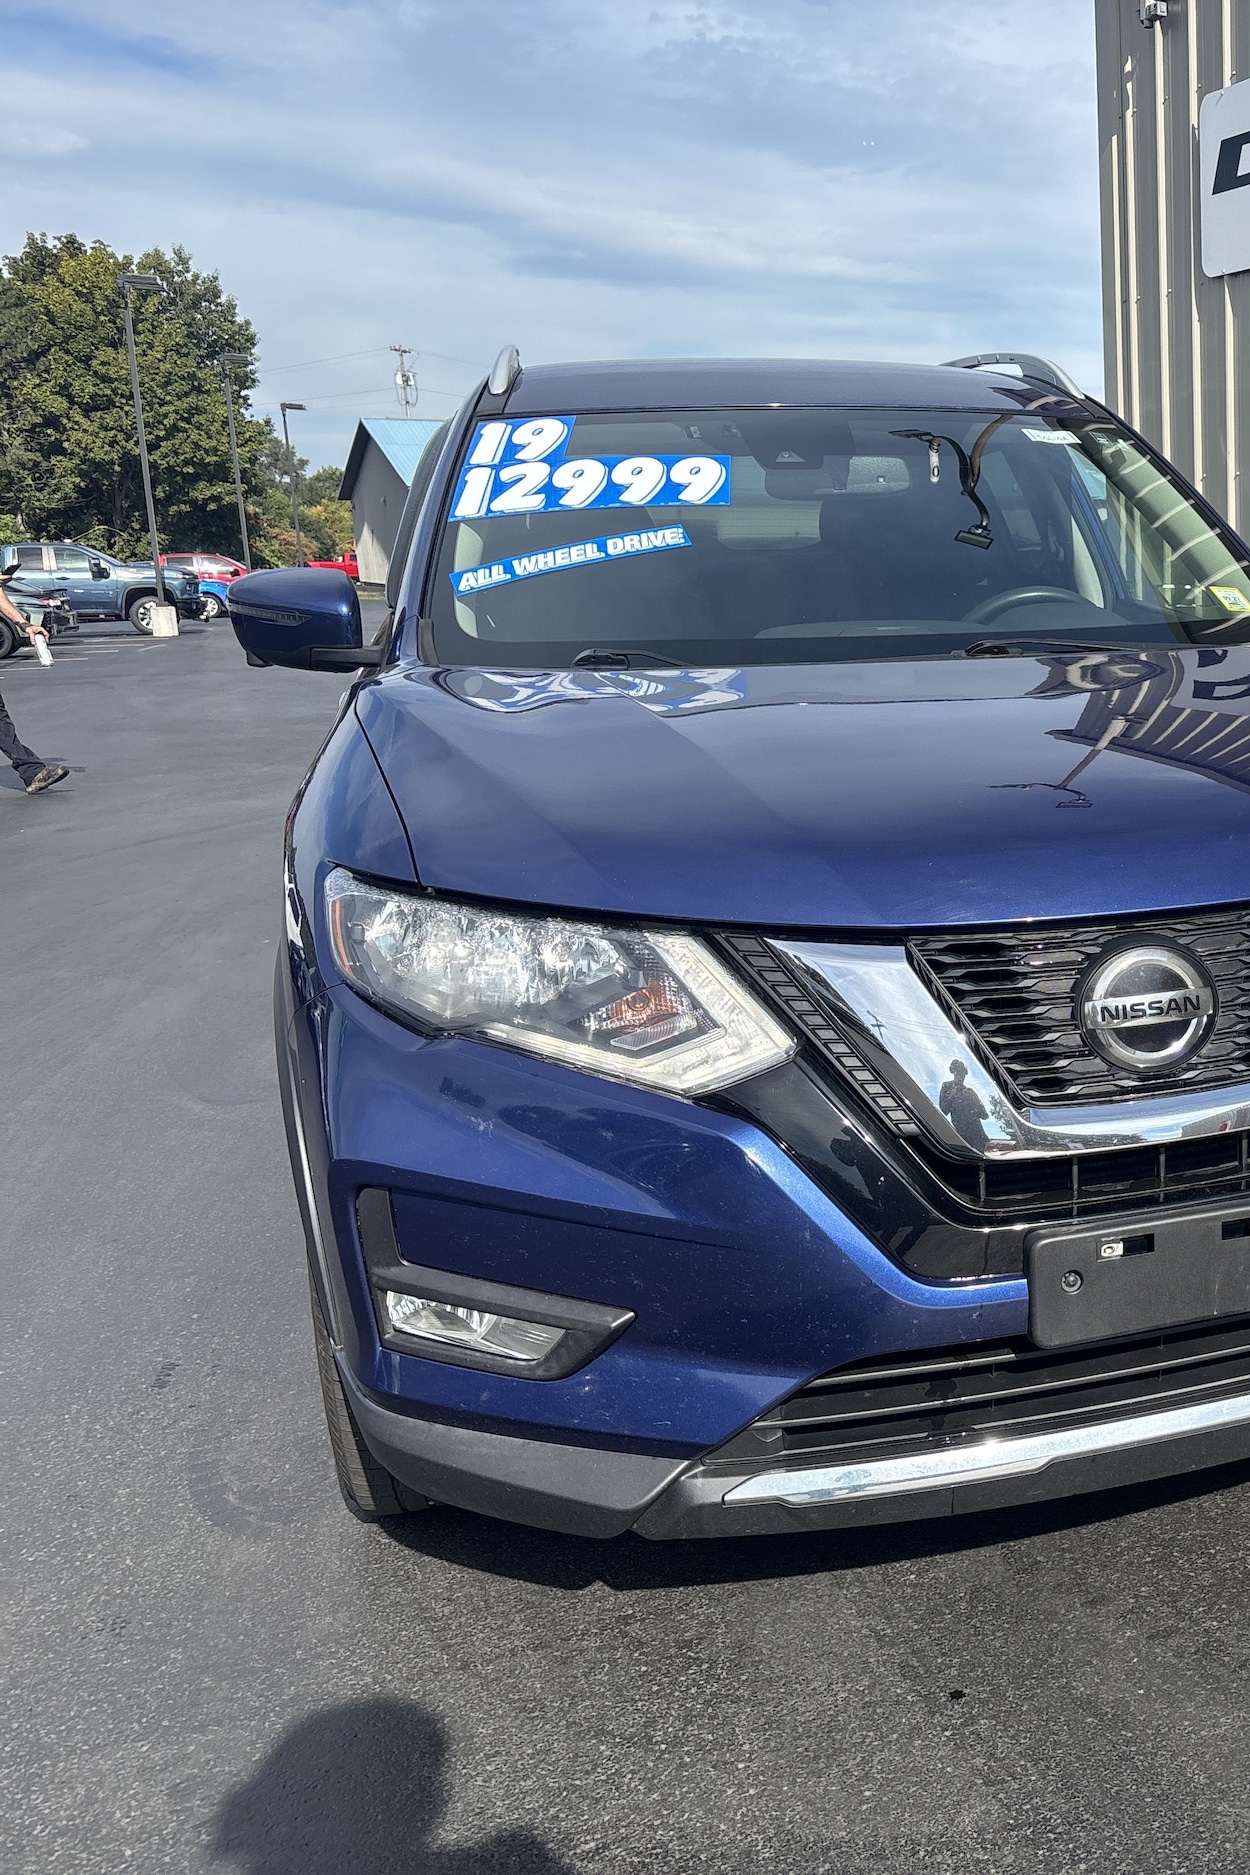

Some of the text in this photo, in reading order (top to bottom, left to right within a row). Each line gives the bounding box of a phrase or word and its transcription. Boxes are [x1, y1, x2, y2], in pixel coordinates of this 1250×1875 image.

[469, 418, 568, 465] 19
[454, 457, 727, 517] 12999
[457, 527, 684, 592] ALL WHEEL DRIVE
[1101, 995, 1200, 1022] NISSAN
